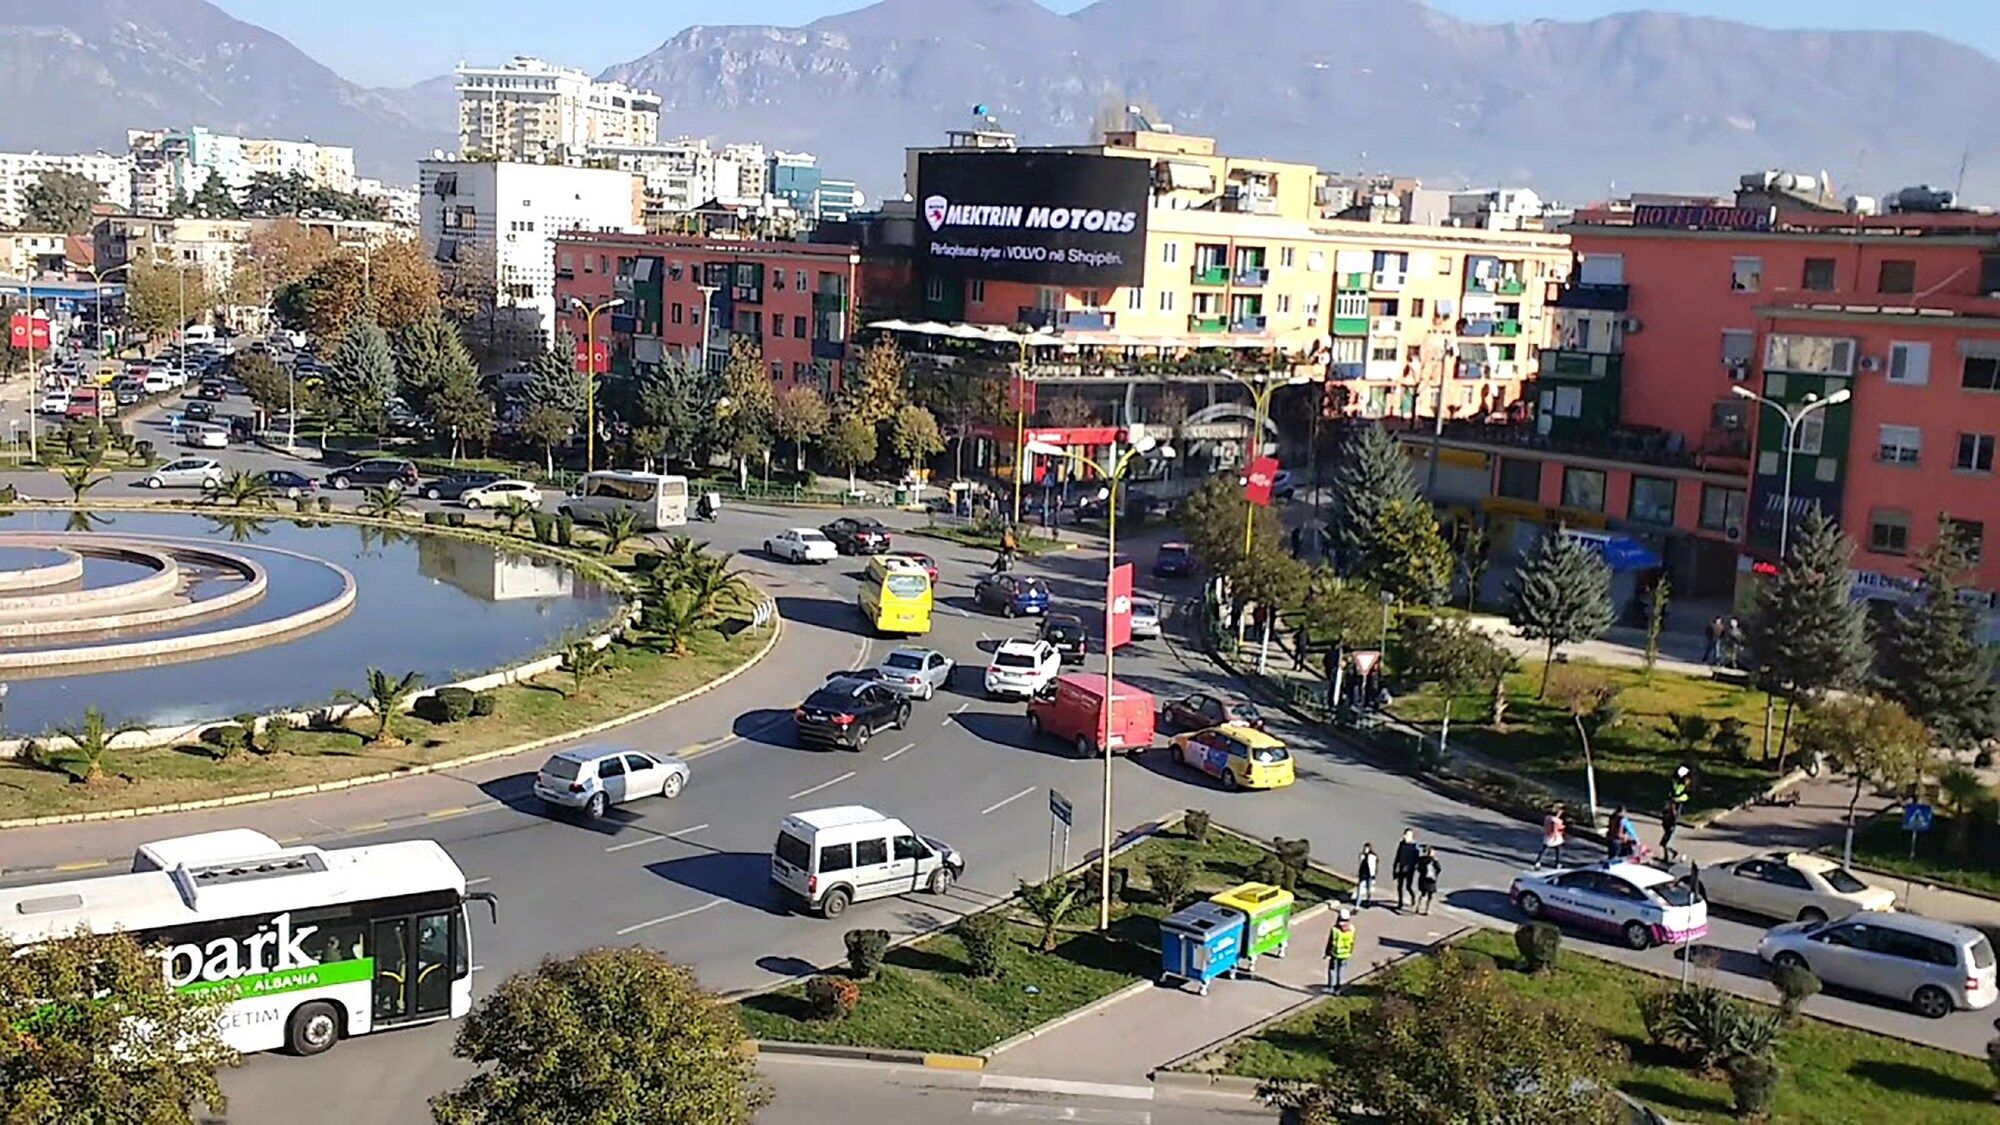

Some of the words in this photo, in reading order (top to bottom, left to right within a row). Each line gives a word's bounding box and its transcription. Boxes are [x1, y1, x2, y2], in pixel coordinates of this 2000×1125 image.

[945, 204, 1022, 226] MEKTRIN
[1025, 206, 1136, 232] MOTORS
[1637, 207, 1694, 225] HOTEL
[1007, 245, 1047, 261] VOLVO
[163, 912, 320, 987] park
[253, 971, 318, 992] ALBANIA
